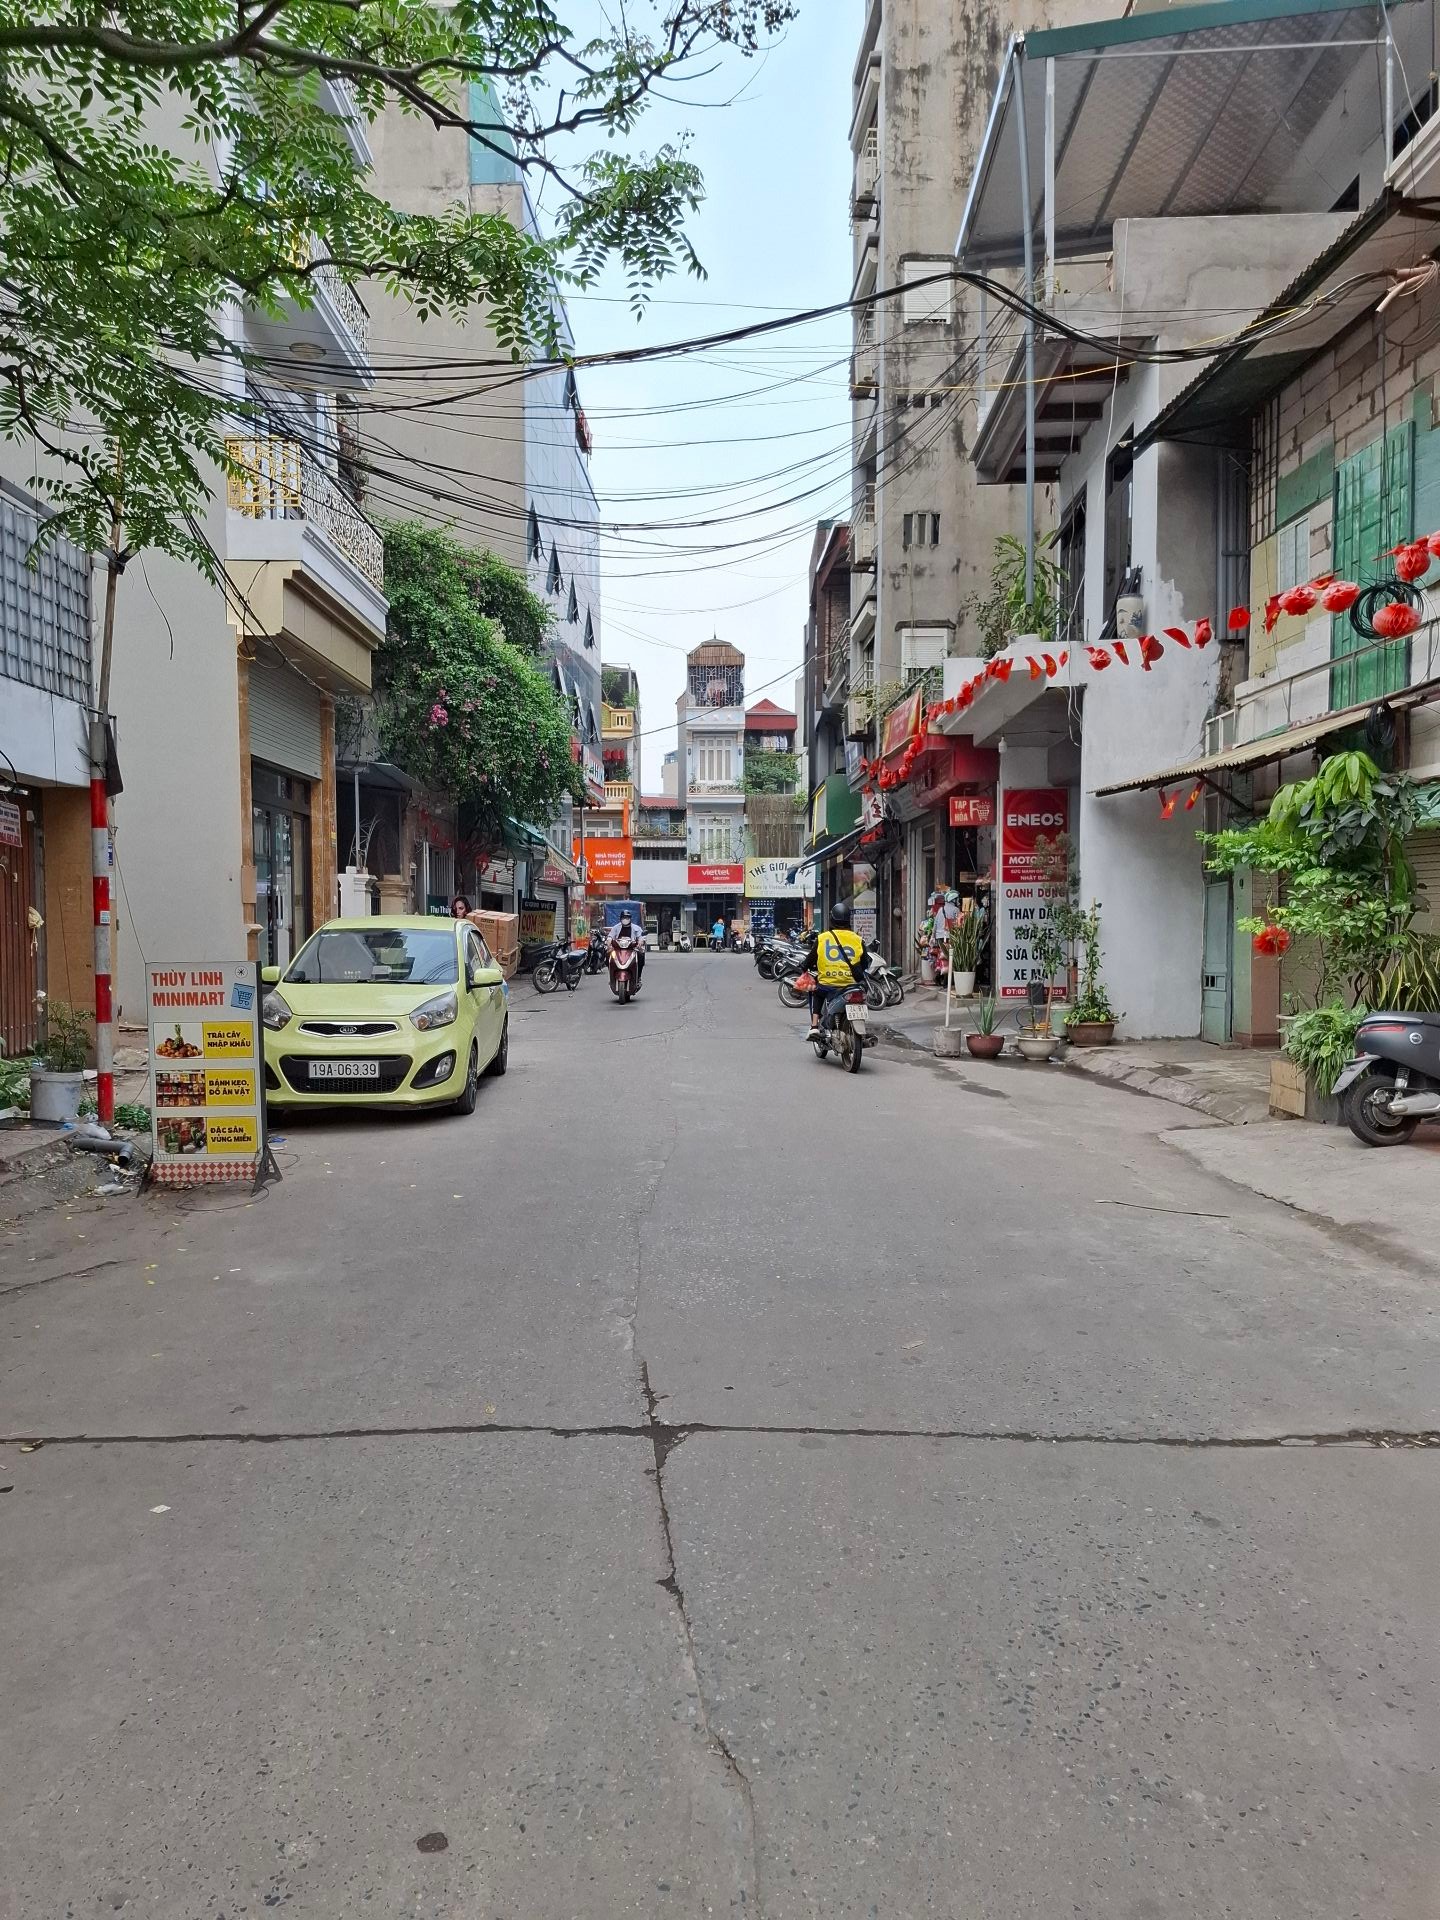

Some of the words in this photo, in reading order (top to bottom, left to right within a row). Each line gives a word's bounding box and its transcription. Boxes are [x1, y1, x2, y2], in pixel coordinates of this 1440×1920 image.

[1007, 813, 1064, 827] ENEOS
[611, 859, 626, 868] VIỆT
[702, 868, 730, 876] viettel
[1006, 888, 1033, 898] OANH
[430, 905, 440, 914] Thu
[1008, 907, 1035, 920] THAY
[825, 939, 856, 962] be
[1006, 945, 1028, 961] SỬA
[151, 969, 186, 986] THÙY
[191, 971, 223, 986] LINH
[1013, 969, 1028, 981] XE
[152, 991, 226, 1007] MINIMART
[207, 1030, 225, 1039] TRÁI
[226, 1030, 241, 1039] CÂY
[207, 1039, 229, 1050] NHẬP
[312, 1063, 377, 1077] 19A-063.39
